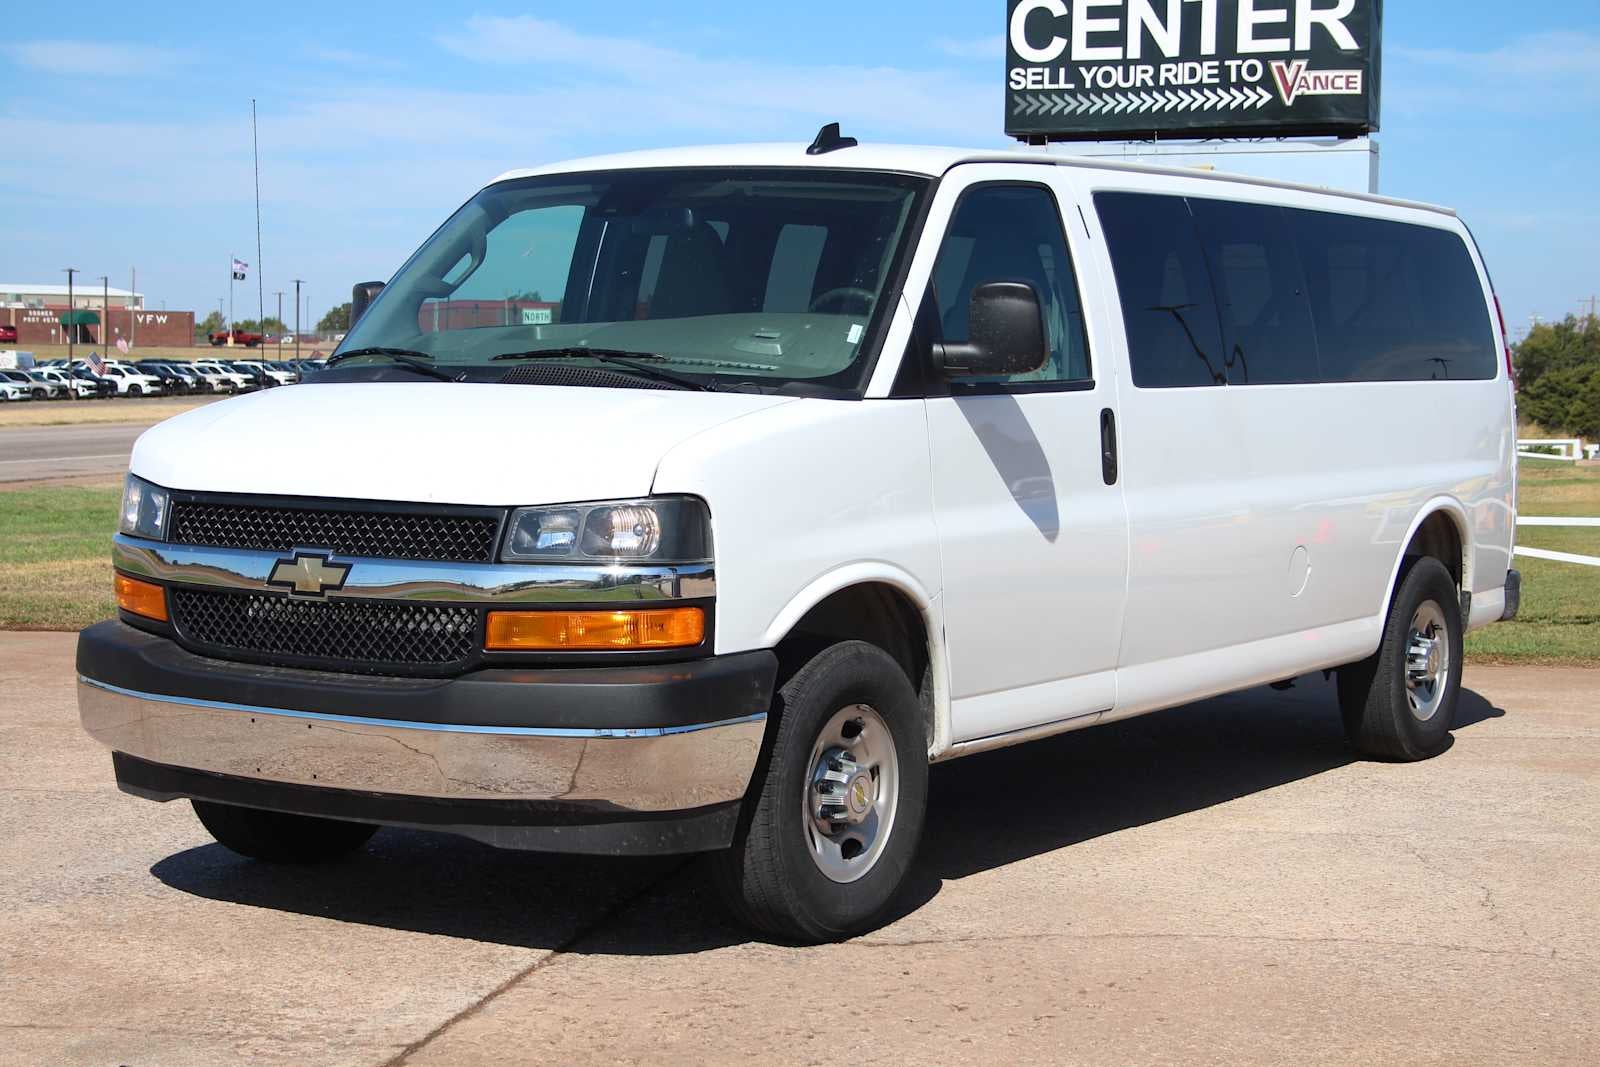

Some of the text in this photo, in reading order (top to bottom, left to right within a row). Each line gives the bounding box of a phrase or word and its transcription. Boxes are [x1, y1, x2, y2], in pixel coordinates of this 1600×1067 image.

[1010, 0, 1360, 62] CENTER
[1009, 59, 1263, 90] SELL YOUR RIDE TO
[1269, 60, 1361, 105] VANCE
[136, 314, 168, 325] VFW
[524, 311, 549, 321] NORTH
